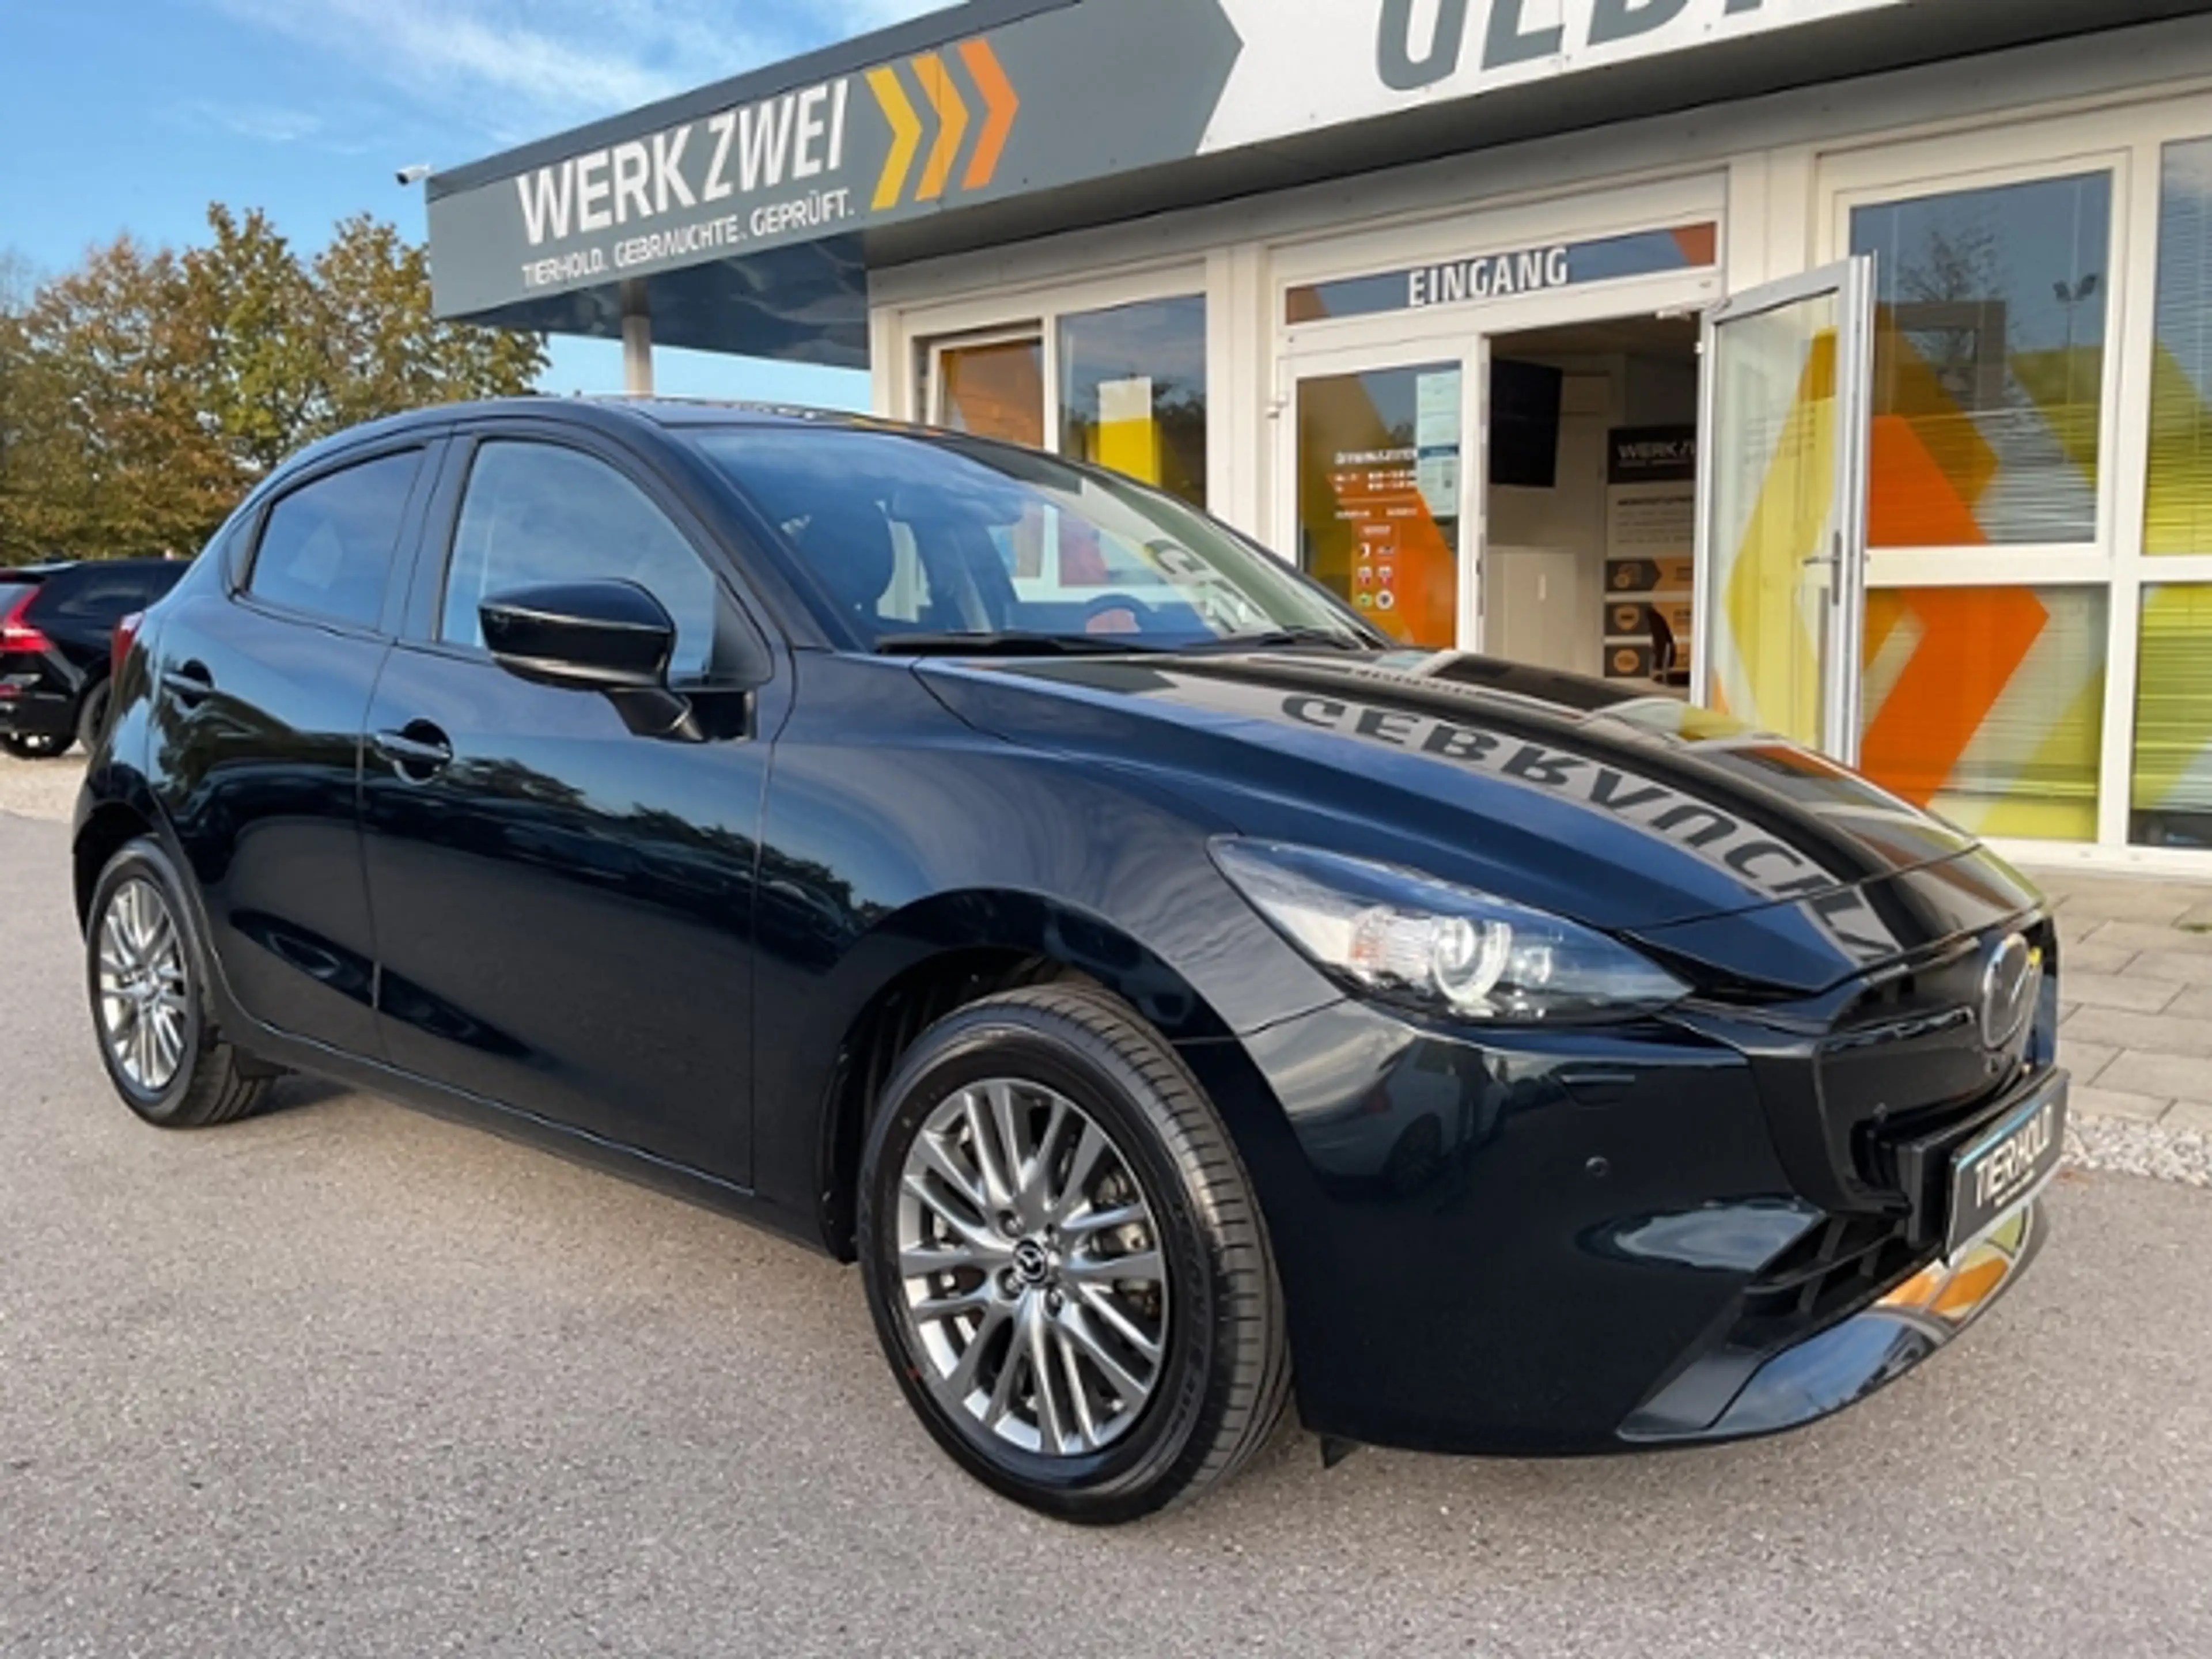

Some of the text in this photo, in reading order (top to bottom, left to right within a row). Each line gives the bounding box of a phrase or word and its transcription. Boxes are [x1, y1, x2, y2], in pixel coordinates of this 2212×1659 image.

[516, 78, 848, 246] WERK ZWEI
[522, 188, 855, 287] TIERHOLD. GEBRAUCHTE. GEPRÜFT.
[1408, 247, 1567, 306] EINGANG
